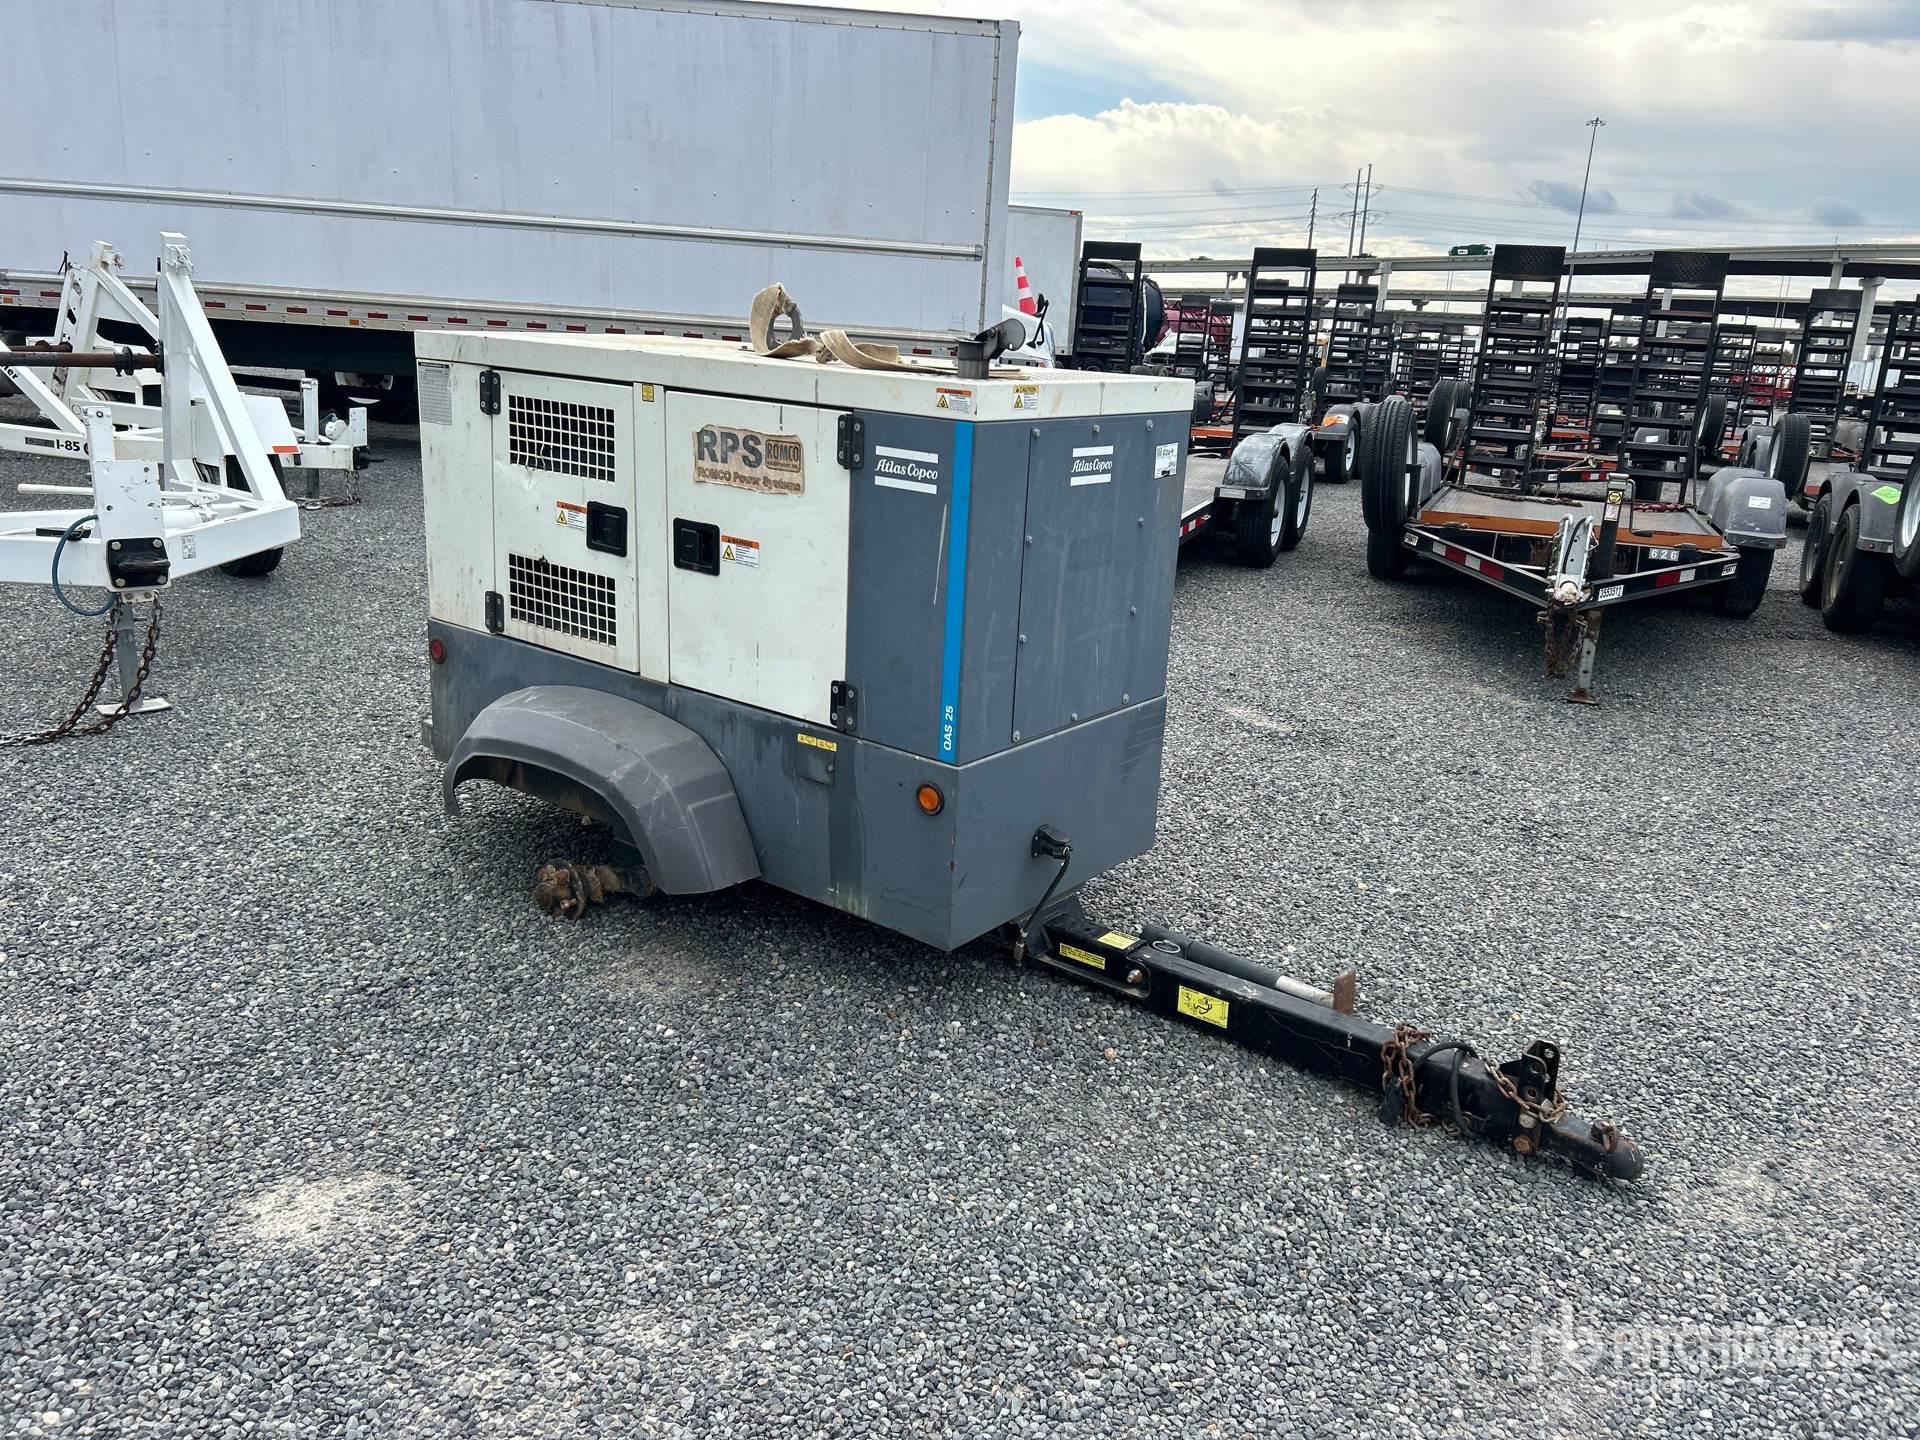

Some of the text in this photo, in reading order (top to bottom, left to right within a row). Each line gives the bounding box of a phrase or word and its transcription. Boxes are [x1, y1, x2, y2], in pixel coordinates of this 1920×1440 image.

[56, 438, 81, 452] I-85
[696, 429, 763, 469] RPS
[767, 443, 800, 462] ROMCO
[874, 458, 938, 480] Atlas Copco
[1070, 458, 1113, 473] Atlas Copco
[697, 466, 801, 492] ROMCO Power Systems
[1651, 549, 1677, 560] 626
[943, 704, 954, 751] QAS 25
